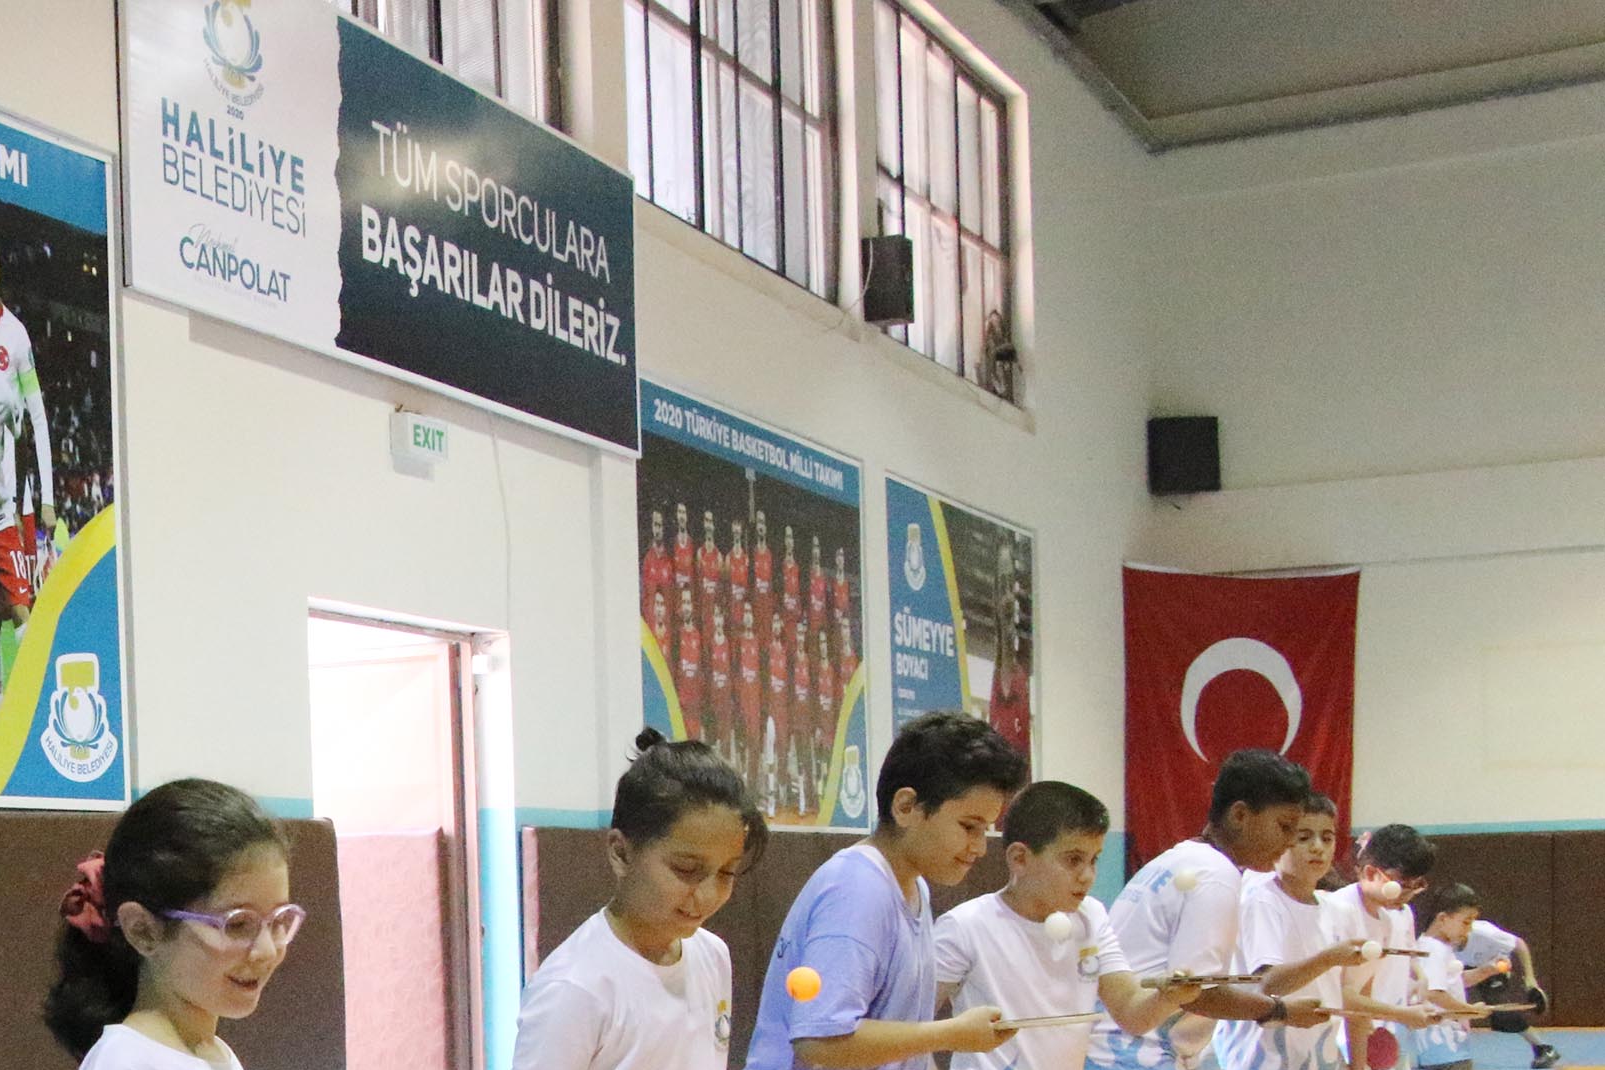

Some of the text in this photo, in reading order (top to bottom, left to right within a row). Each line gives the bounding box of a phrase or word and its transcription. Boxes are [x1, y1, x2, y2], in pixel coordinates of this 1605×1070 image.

[161, 97, 305, 196] HALİLİYE
[163, 142, 306, 238] BELEDİYESİ
[372, 120, 610, 284] TÜM SPORCULARA
[179, 236, 291, 302] CANPOLAT
[361, 203, 627, 366] BAŞARILAR DİLERİZ.
[413, 423, 444, 453] EXIT
[654, 398, 683, 429] 2020
[684, 408, 730, 448] TÜRKİYE
[731, 427, 789, 472] BASKETBOL
[894, 606, 955, 658] SÜMEYYE
